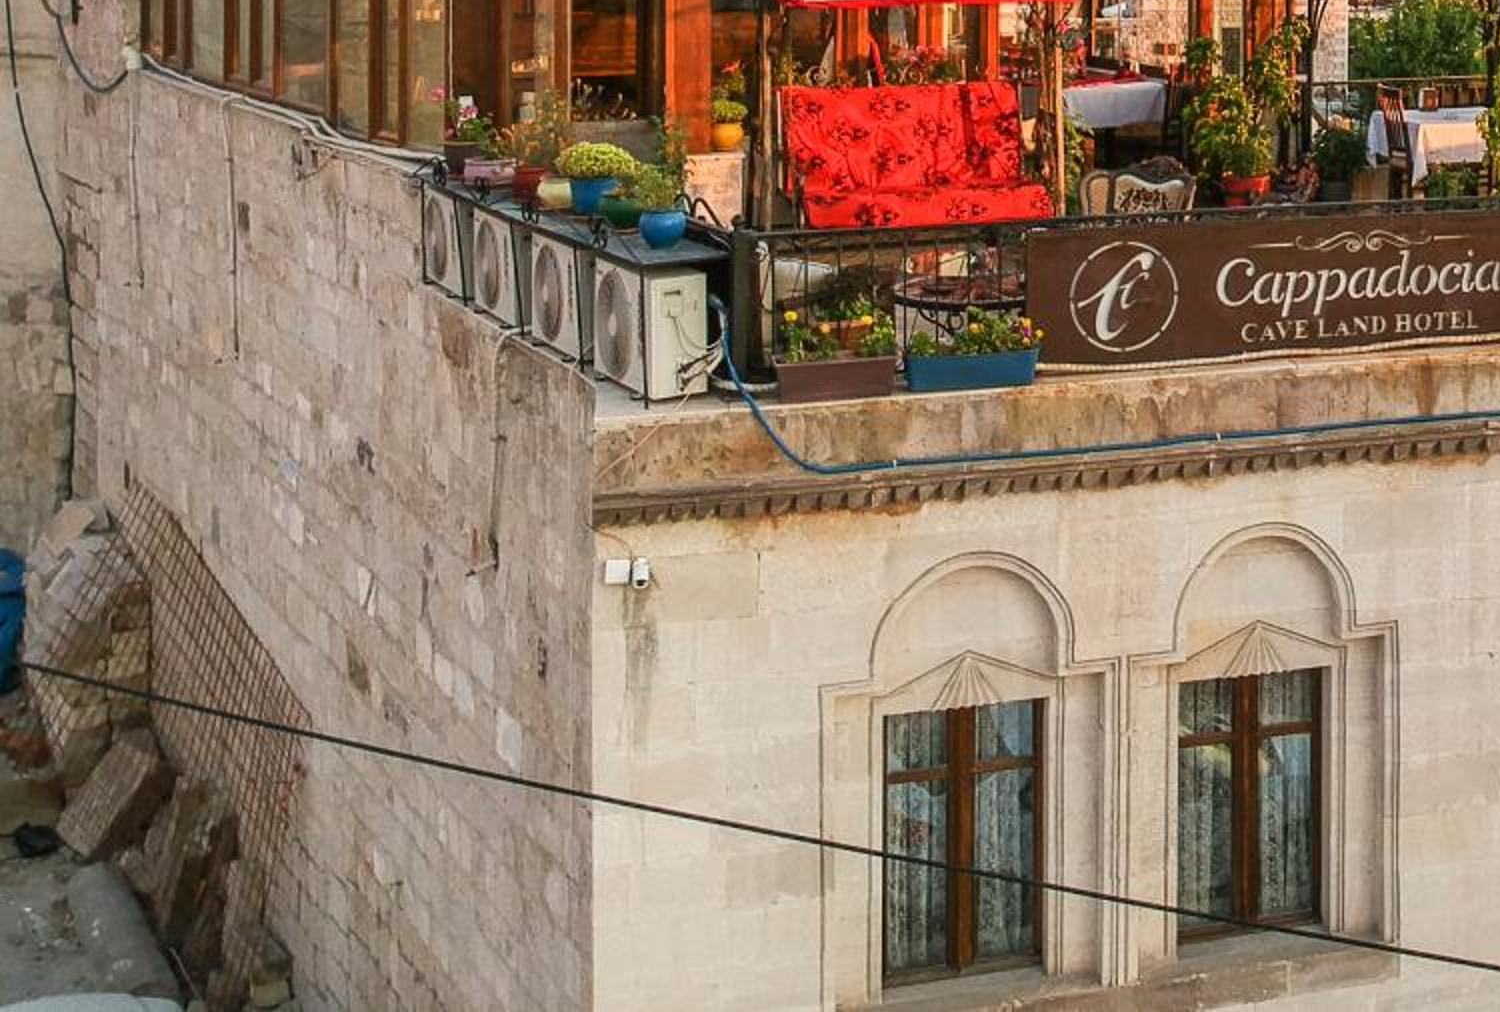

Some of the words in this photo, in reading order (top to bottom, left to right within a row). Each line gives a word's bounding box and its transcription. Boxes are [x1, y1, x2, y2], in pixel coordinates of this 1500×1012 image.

[1216, 249, 1500, 317] Cappadocia
[1241, 319, 1309, 342] CAVE
[1317, 315, 1387, 338] LAND
[1394, 309, 1479, 333] HOTEL
